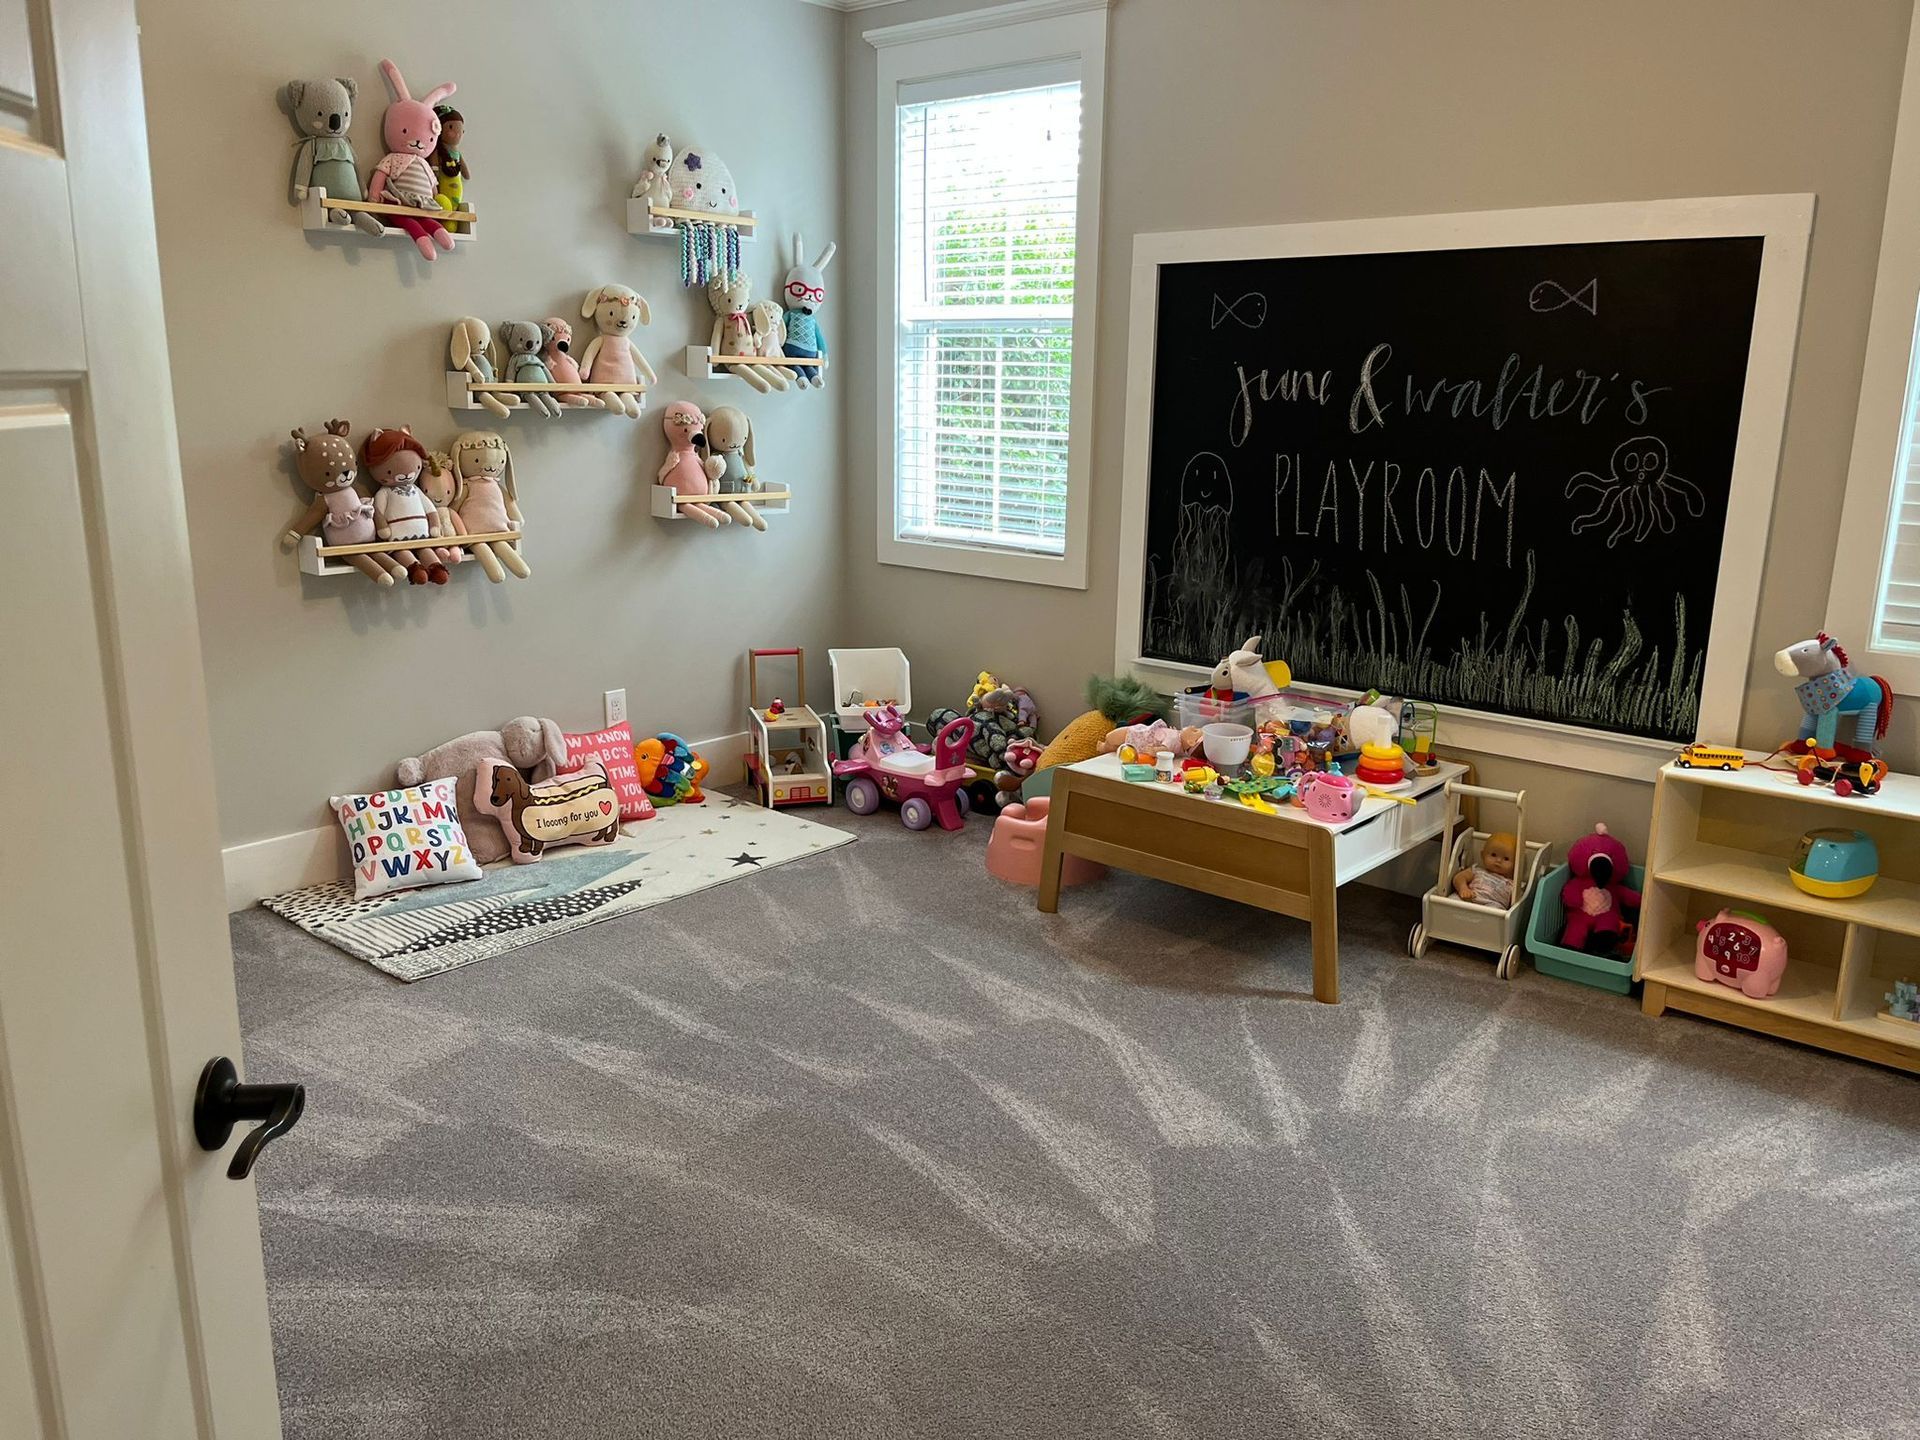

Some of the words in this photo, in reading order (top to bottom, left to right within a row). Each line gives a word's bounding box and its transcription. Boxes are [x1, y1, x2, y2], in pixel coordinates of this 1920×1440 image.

[1230, 361, 1333, 447] june
[1350, 343, 1393, 433] &
[1405, 353, 1672, 430] walter's
[1275, 452, 1516, 569] PLAYROOM
[595, 730, 631, 745] KNOW
[609, 765, 637, 780] TIME
[620, 782, 643, 797] YOU
[570, 812, 582, 822] for
[584, 809, 599, 821] you
[1708, 934, 1714, 944] 4
[1733, 942, 1740, 951] 6
[1727, 932, 1736, 942] 2
[1724, 950, 1731, 960] 9
